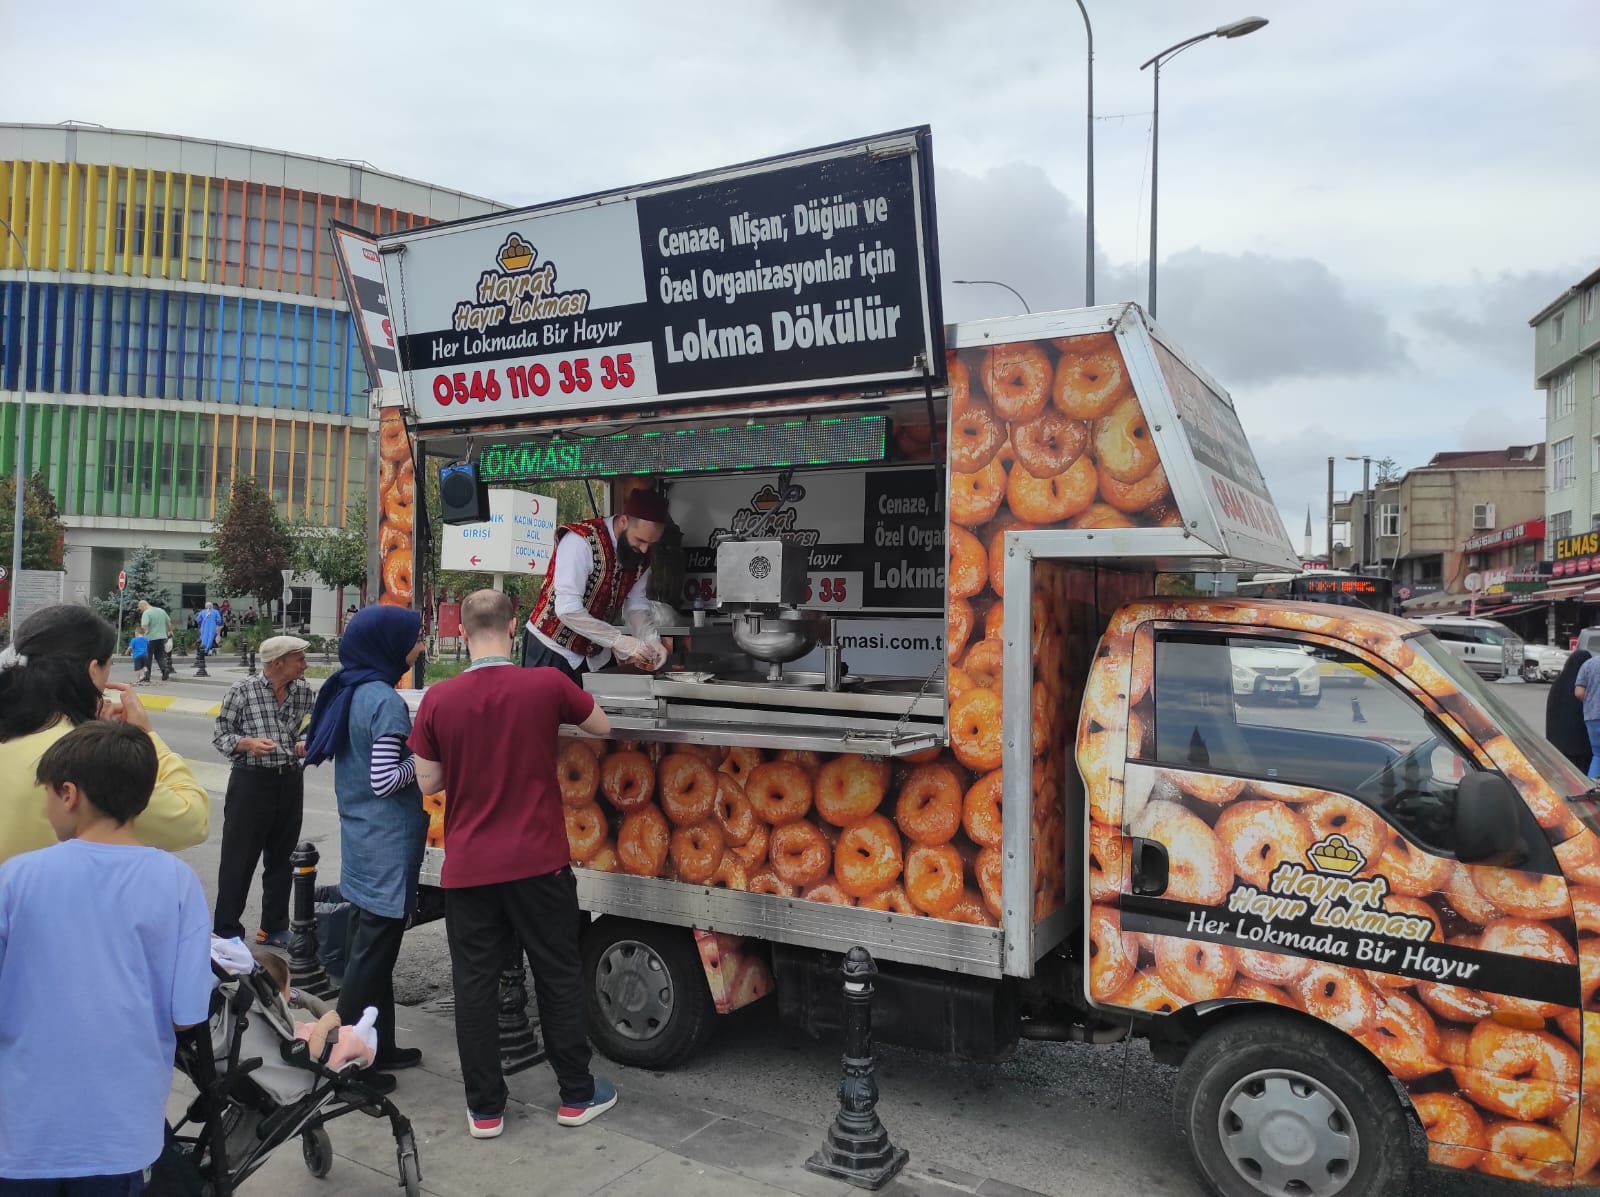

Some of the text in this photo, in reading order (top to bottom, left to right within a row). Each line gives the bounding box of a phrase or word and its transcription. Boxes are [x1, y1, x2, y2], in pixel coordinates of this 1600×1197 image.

[658, 195, 888, 257] Cenaze, Nişan, Düğün ve
[479, 265, 554, 305] Hayrat
[659, 240, 896, 304] Özel Organizasyonlar için
[455, 293, 588, 333] Hayır Lokması
[664, 294, 901, 364] Lokma Dökülür
[432, 318, 623, 361] Her Lokmada Bir Hayır
[432, 352, 636, 406] 0546 110 35 35
[878, 494, 929, 516] Cenaze,
[875, 520, 904, 546] Özel
[1557, 532, 1599, 560] ELMAS
[687, 551, 711, 569] Her
[819, 577, 847, 603] 35
[1271, 864, 1387, 908] Hayrat
[1228, 886, 1432, 941] Hayır Lokması
[1187, 911, 1480, 979] Her Lokmada Bir Hayır
